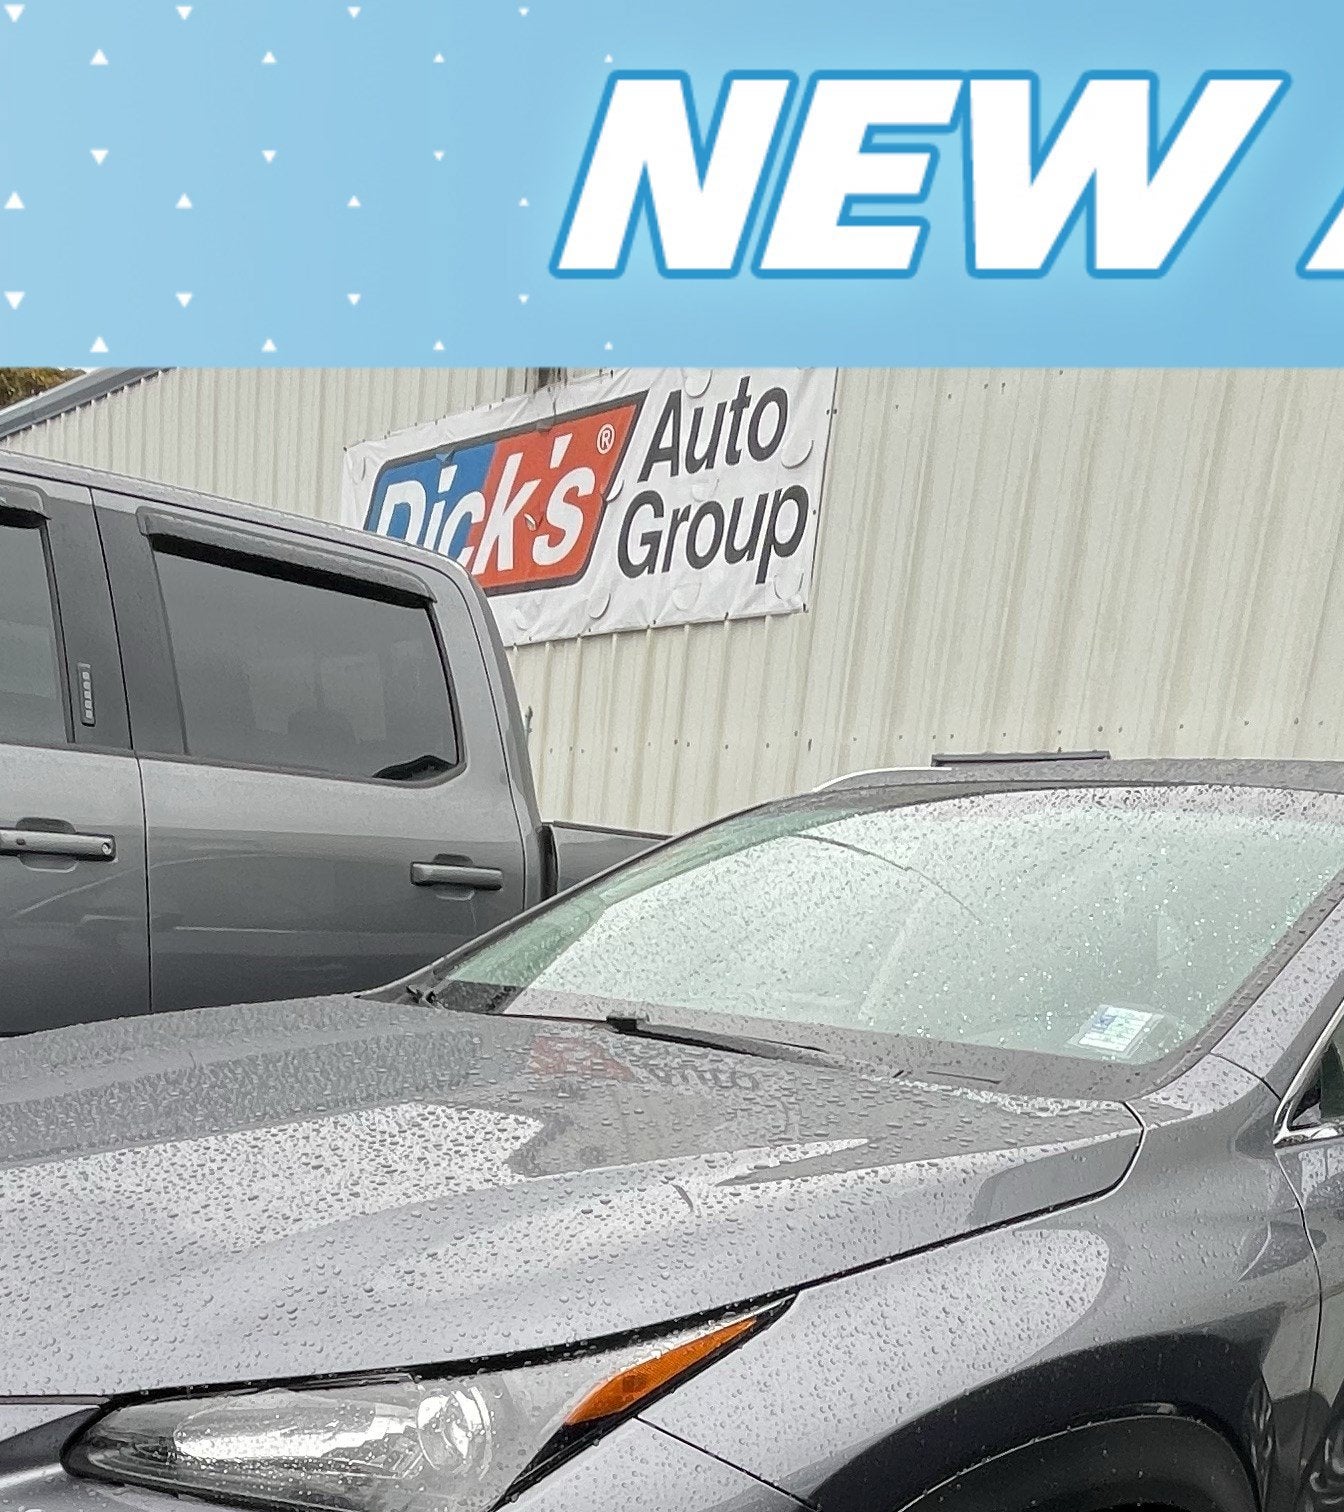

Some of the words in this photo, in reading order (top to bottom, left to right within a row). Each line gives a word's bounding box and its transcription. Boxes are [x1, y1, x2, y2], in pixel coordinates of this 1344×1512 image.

[637, 376, 788, 482] Auto
[376, 433, 595, 574] Dick's
[617, 484, 809, 584] Group
